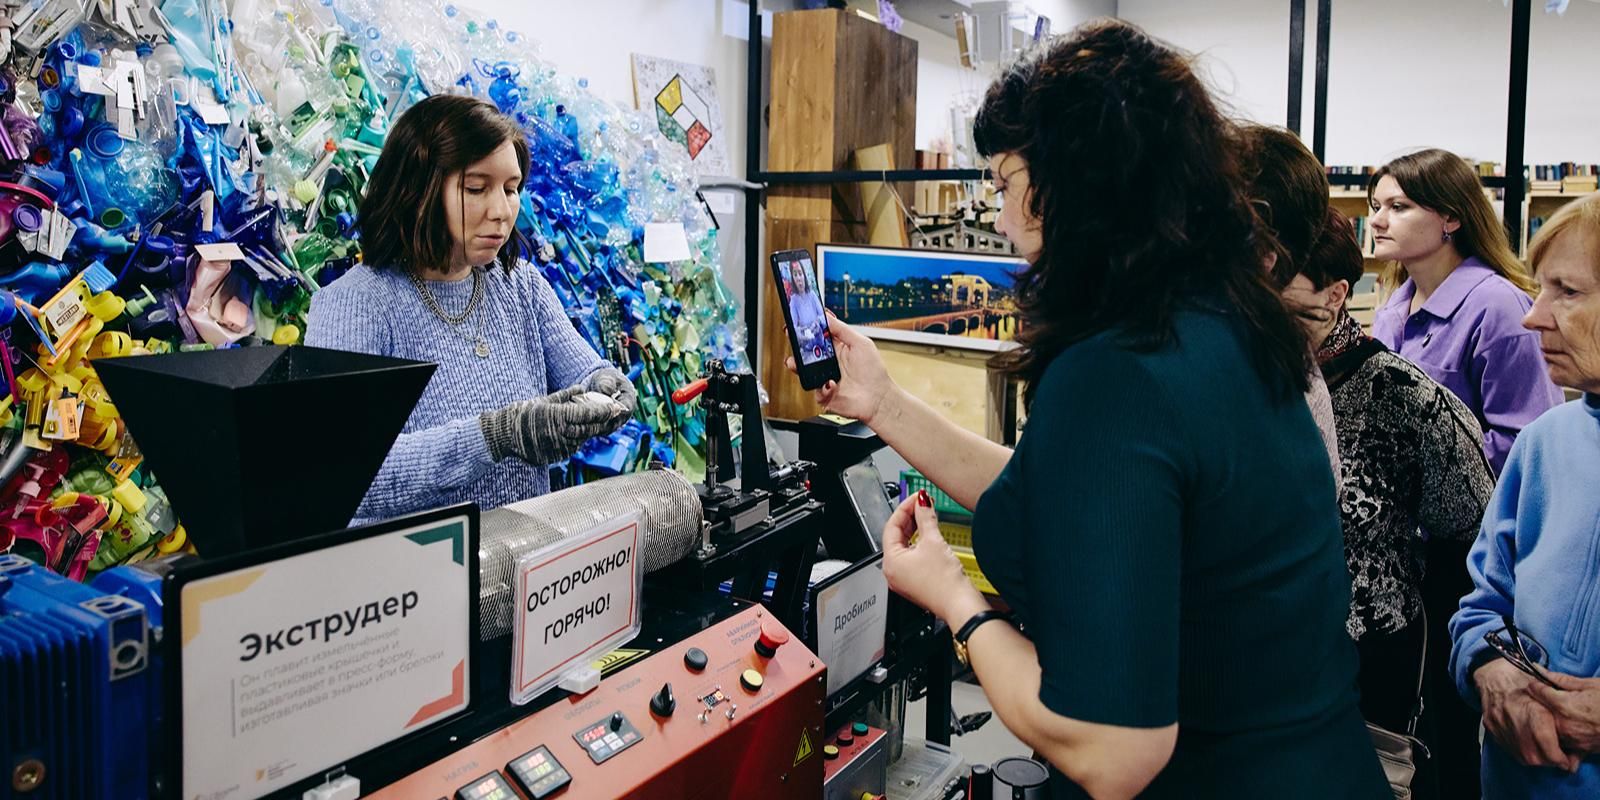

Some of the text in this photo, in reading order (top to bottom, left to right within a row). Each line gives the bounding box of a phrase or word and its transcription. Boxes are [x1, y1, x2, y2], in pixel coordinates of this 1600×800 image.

[527, 546, 631, 612] ОСТОРОЖНО!
[240, 590, 418, 661] Экструдер
[545, 593, 610, 645] ГОРЯЧО!
[834, 594, 876, 634] Дробилка
[240, 640, 400, 701] пластиковые крышечки и
[240, 680, 325, 718] выдавливает
[328, 676, 335, 687] в
[241, 674, 260, 687] Он
[263, 656, 309, 679] плавит
[240, 692, 329, 733] изготавливая
[332, 677, 373, 699] значки
[376, 667, 397, 682] или
